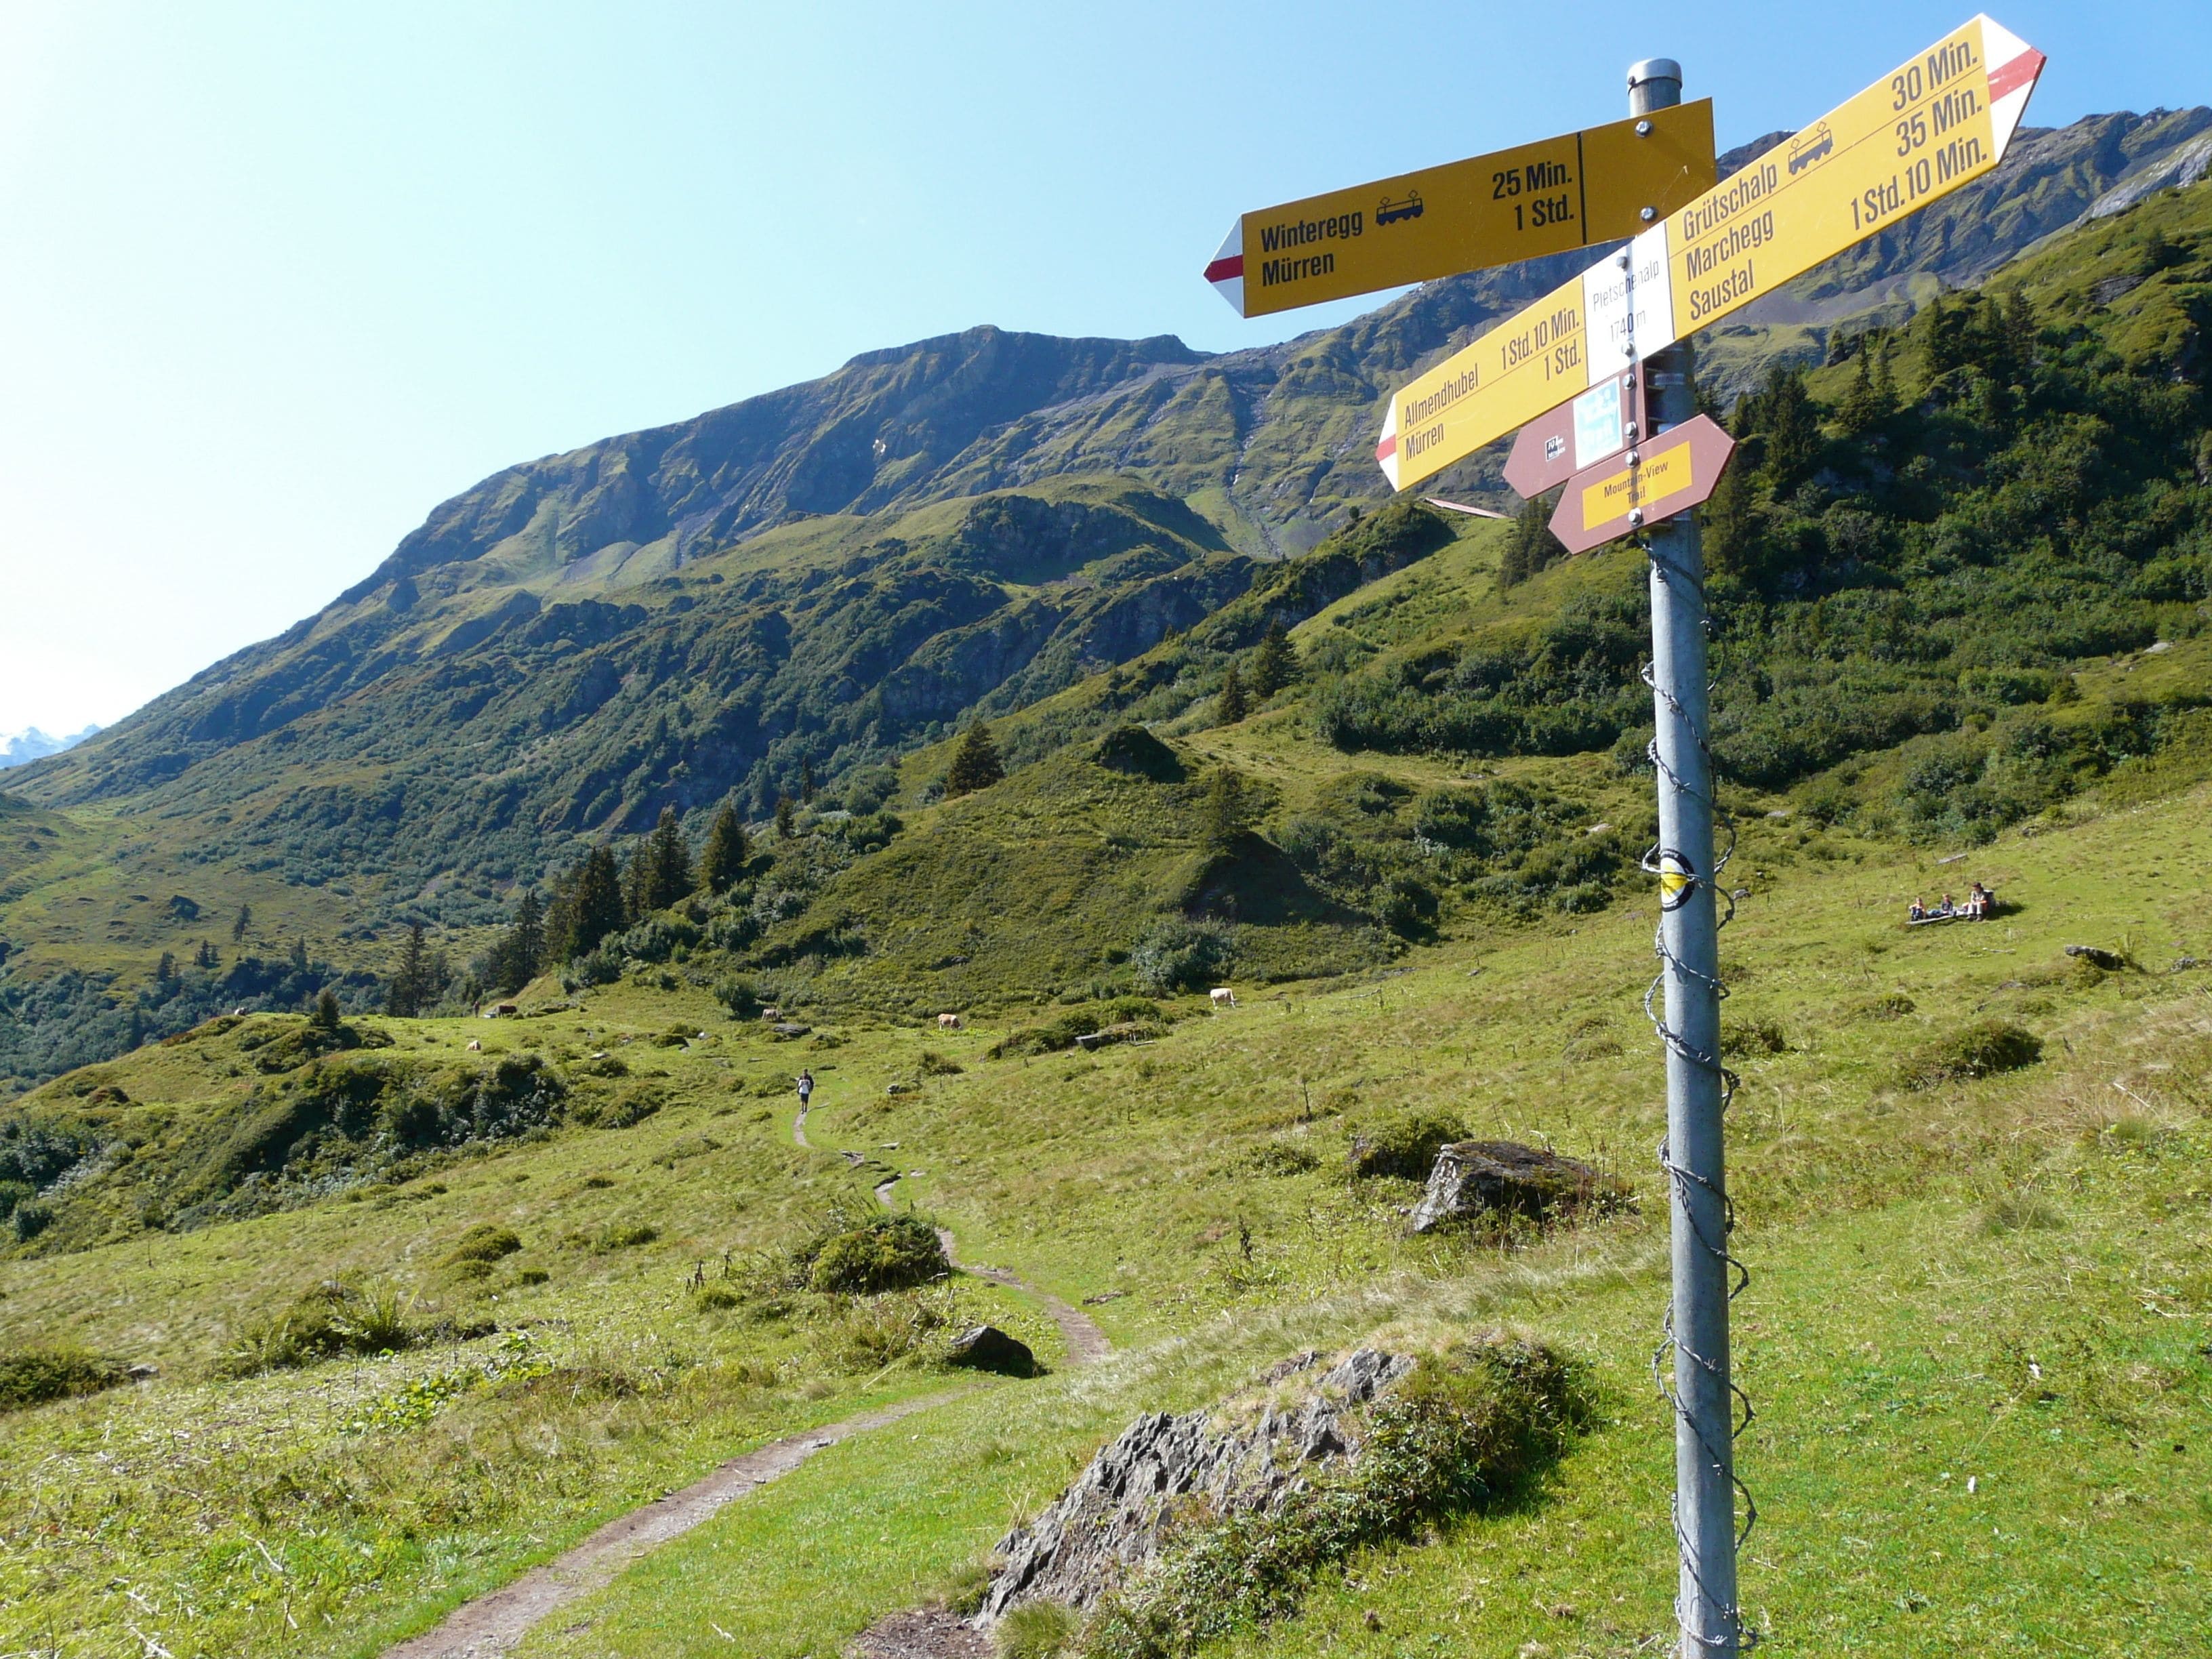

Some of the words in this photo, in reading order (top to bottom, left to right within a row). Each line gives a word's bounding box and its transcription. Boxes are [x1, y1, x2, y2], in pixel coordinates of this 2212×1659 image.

[1891, 65, 1922, 111] 30
[1927, 41, 1978, 90] Min.
[1896, 110, 1926, 157] 35
[1932, 89, 1982, 137] Min.
[1492, 168, 1521, 201] 25
[1526, 161, 1572, 192] Min.
[1683, 163, 1777, 241] Grütschalp
[1851, 197, 1860, 230] 1
[1864, 175, 1905, 224] Std.
[1906, 158, 1931, 200] 10
[1936, 137, 1987, 184] Min.
[1261, 211, 1362, 253] Winteregg
[1515, 204, 1523, 230] 1
[1532, 194, 1574, 227] Std.
[1686, 209, 1774, 282] Marchegg
[1263, 253, 1334, 287] Mürren
[1593, 260, 1659, 312] Pletschenalp
[1690, 258, 1754, 321] Saustal
[1501, 344, 1507, 370] 1
[1509, 331, 1533, 365] Std.
[1534, 320, 1548, 351] 10
[1551, 308, 1580, 341] Min.
[1610, 312, 1634, 342] 1740
[1636, 310, 1646, 328] m
[1544, 354, 1550, 381] 1
[1555, 338, 1581, 375] Std.
[1405, 363, 1479, 430] Allmendhubel
[1406, 423, 1444, 462] Mürren
[1603, 462, 1668, 498] Mountain-View
[1627, 486, 1646, 504] Trail
